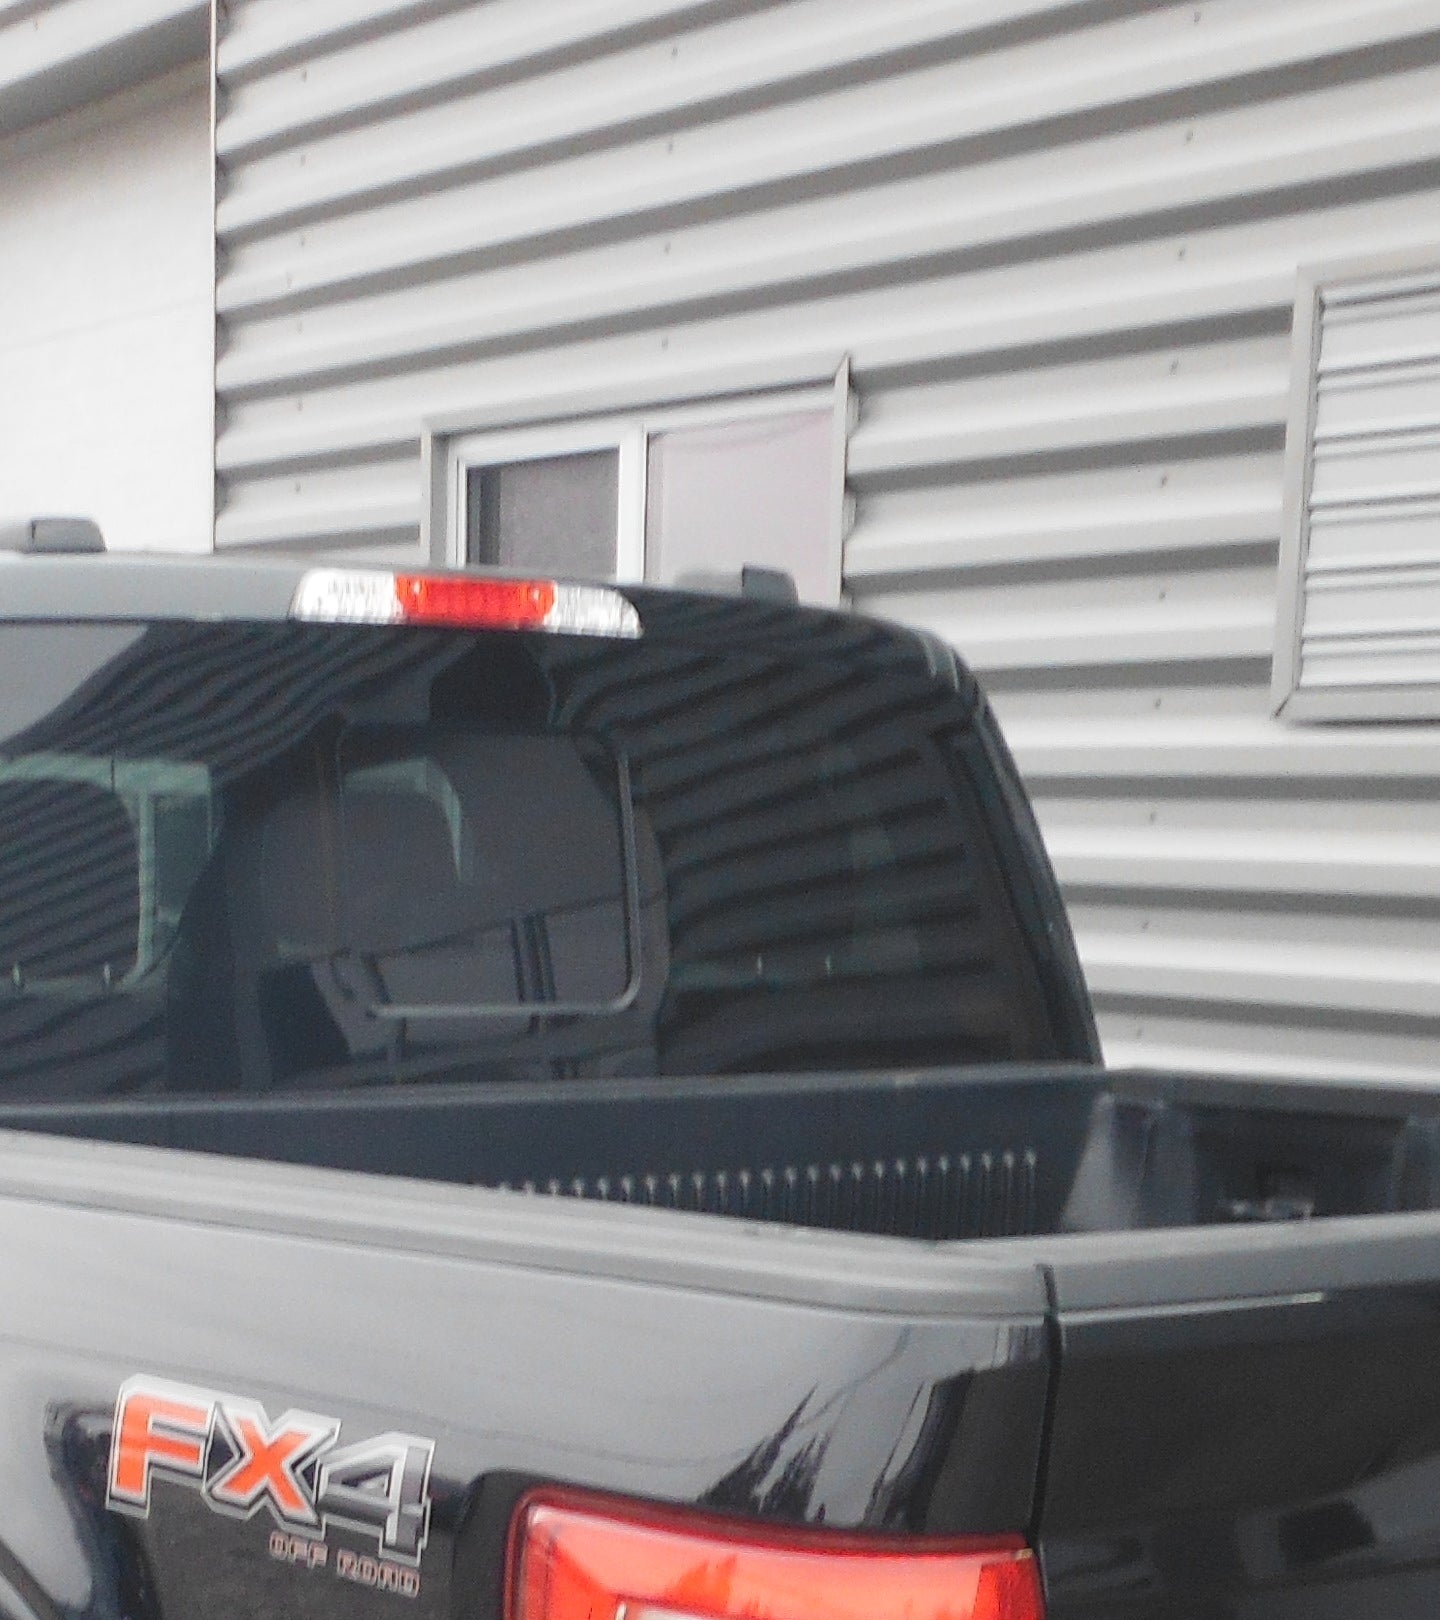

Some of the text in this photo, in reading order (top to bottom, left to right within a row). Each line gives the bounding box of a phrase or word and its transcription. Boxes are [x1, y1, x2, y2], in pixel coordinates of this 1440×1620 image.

[105, 1373, 436, 1567] FX4
[269, 1530, 421, 1599] OFF ROAD
